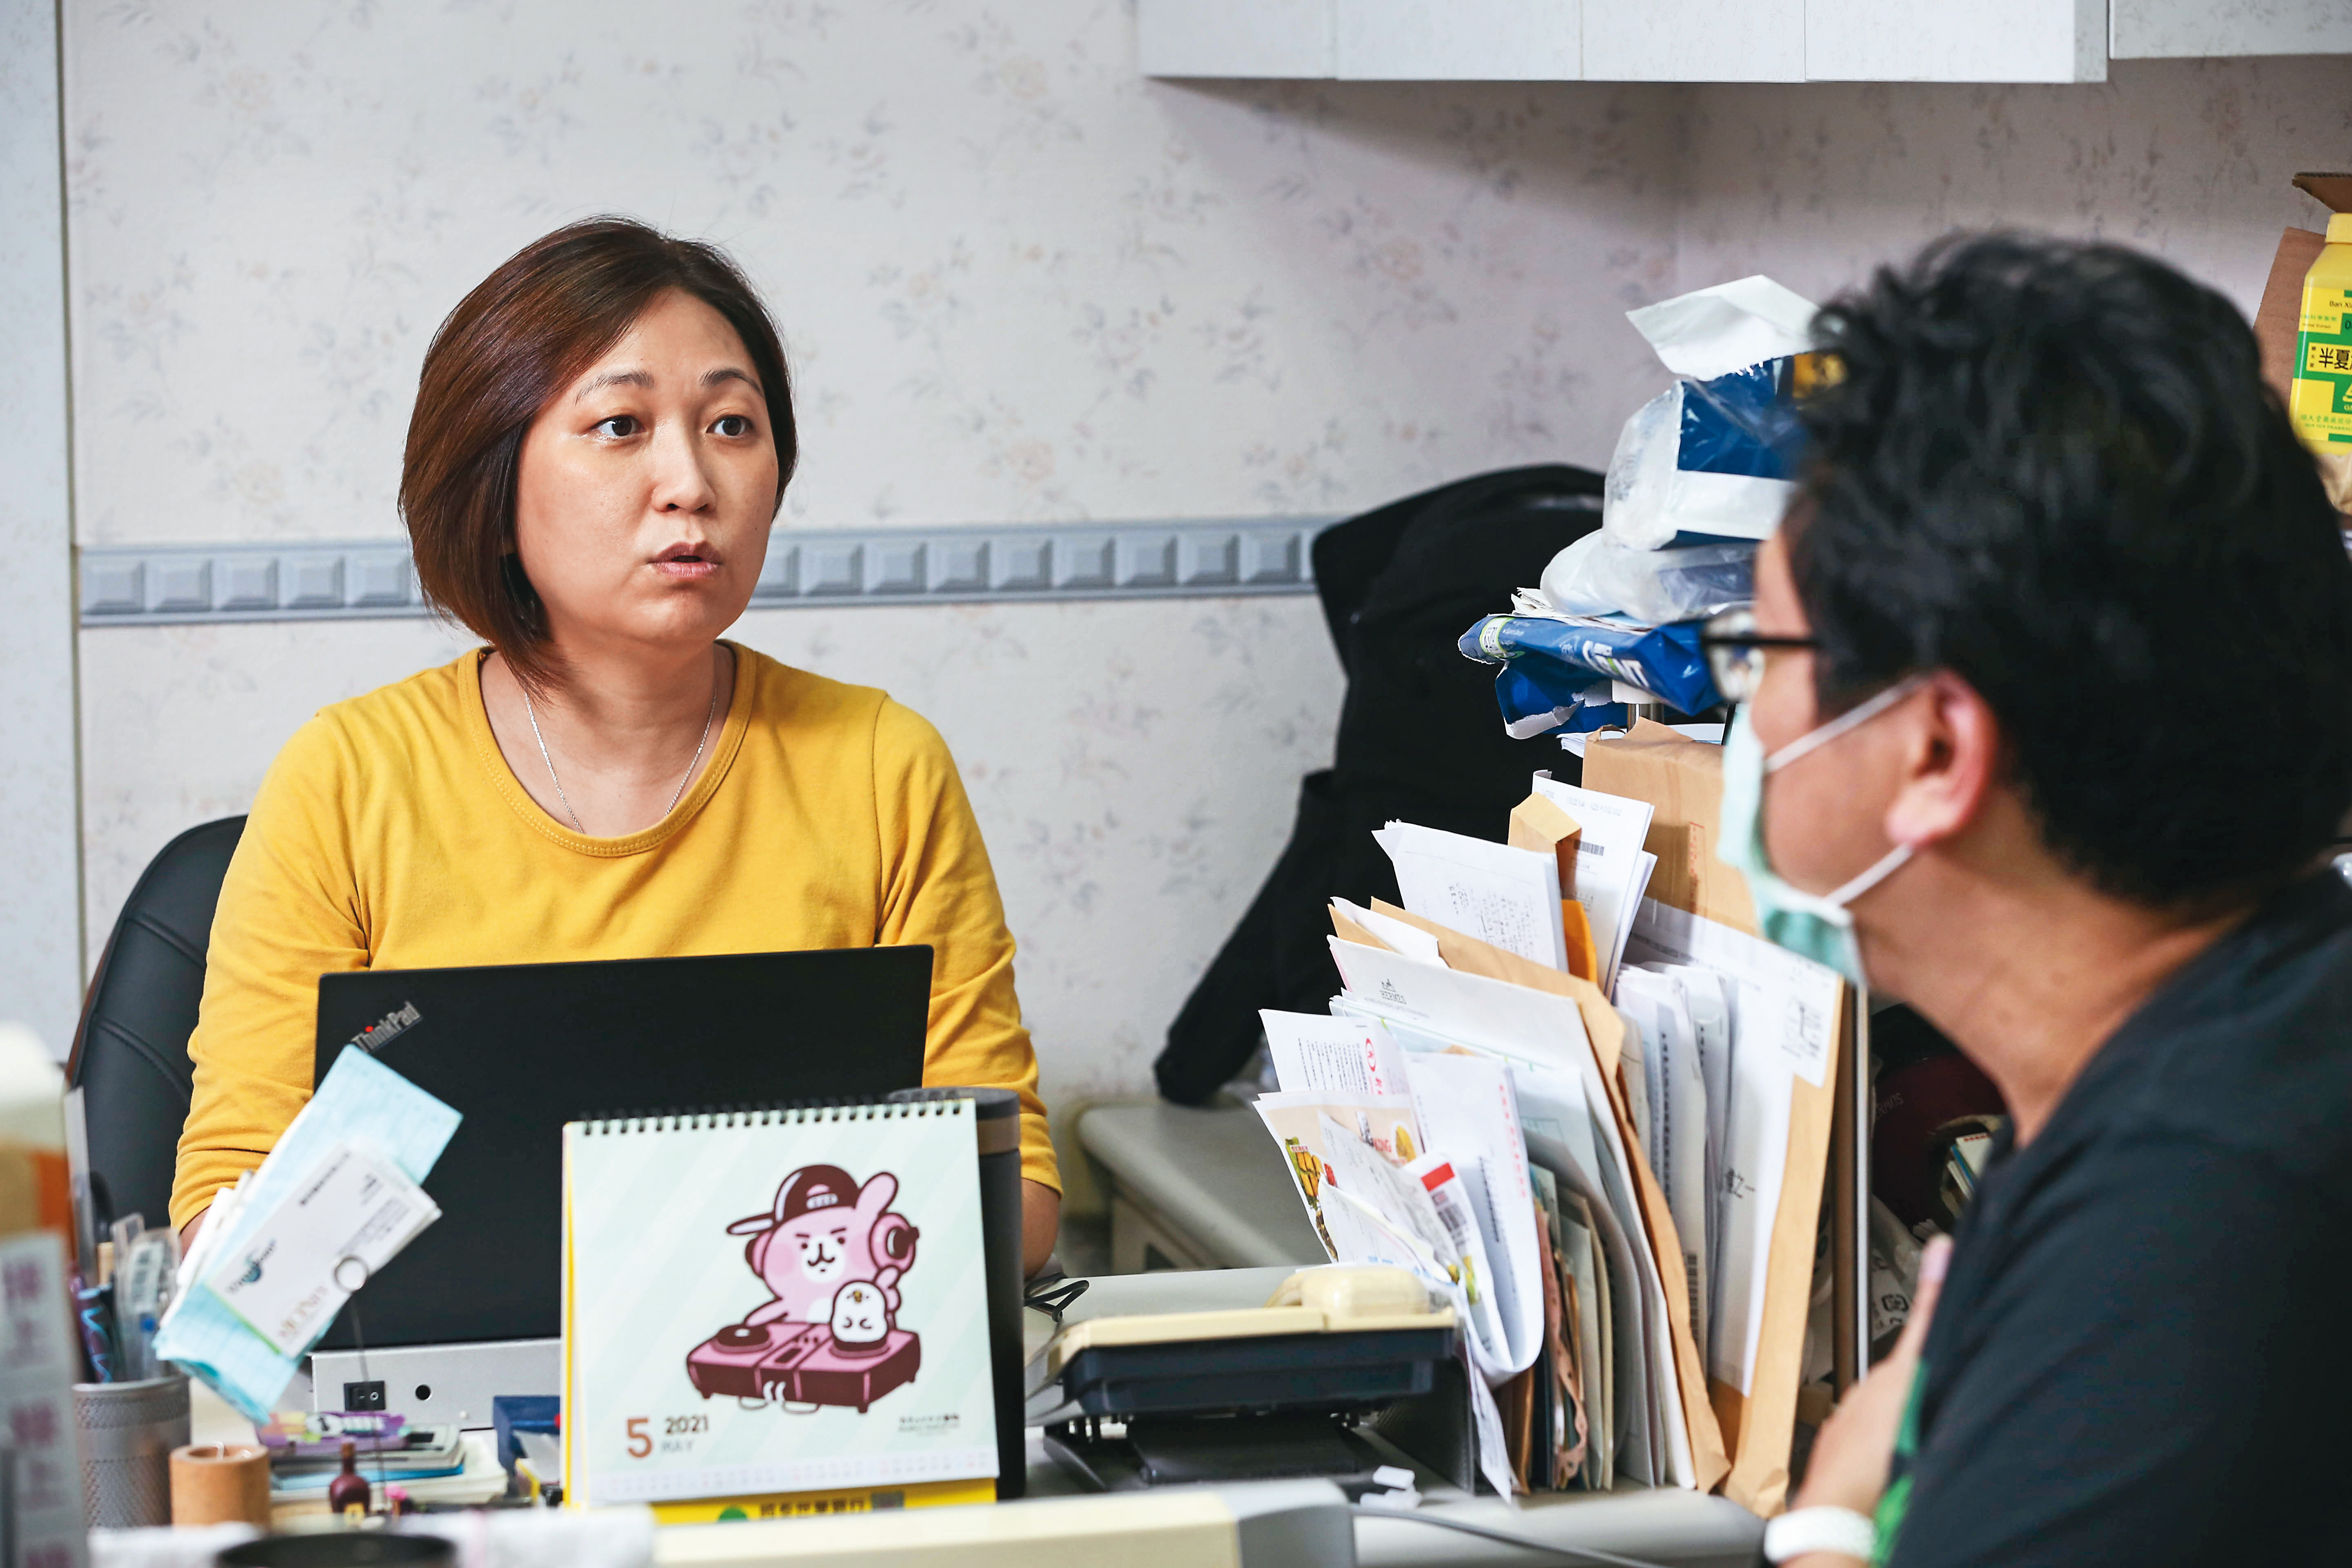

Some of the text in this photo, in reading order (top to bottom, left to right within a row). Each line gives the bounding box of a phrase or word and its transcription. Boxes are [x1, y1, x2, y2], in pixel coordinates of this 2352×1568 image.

[2319, 347, 2352, 370] 半夏
[351, 1000, 421, 1053] ThinkPad
[627, 1417, 652, 1459] 5
[666, 1414, 708, 1434] 2021
